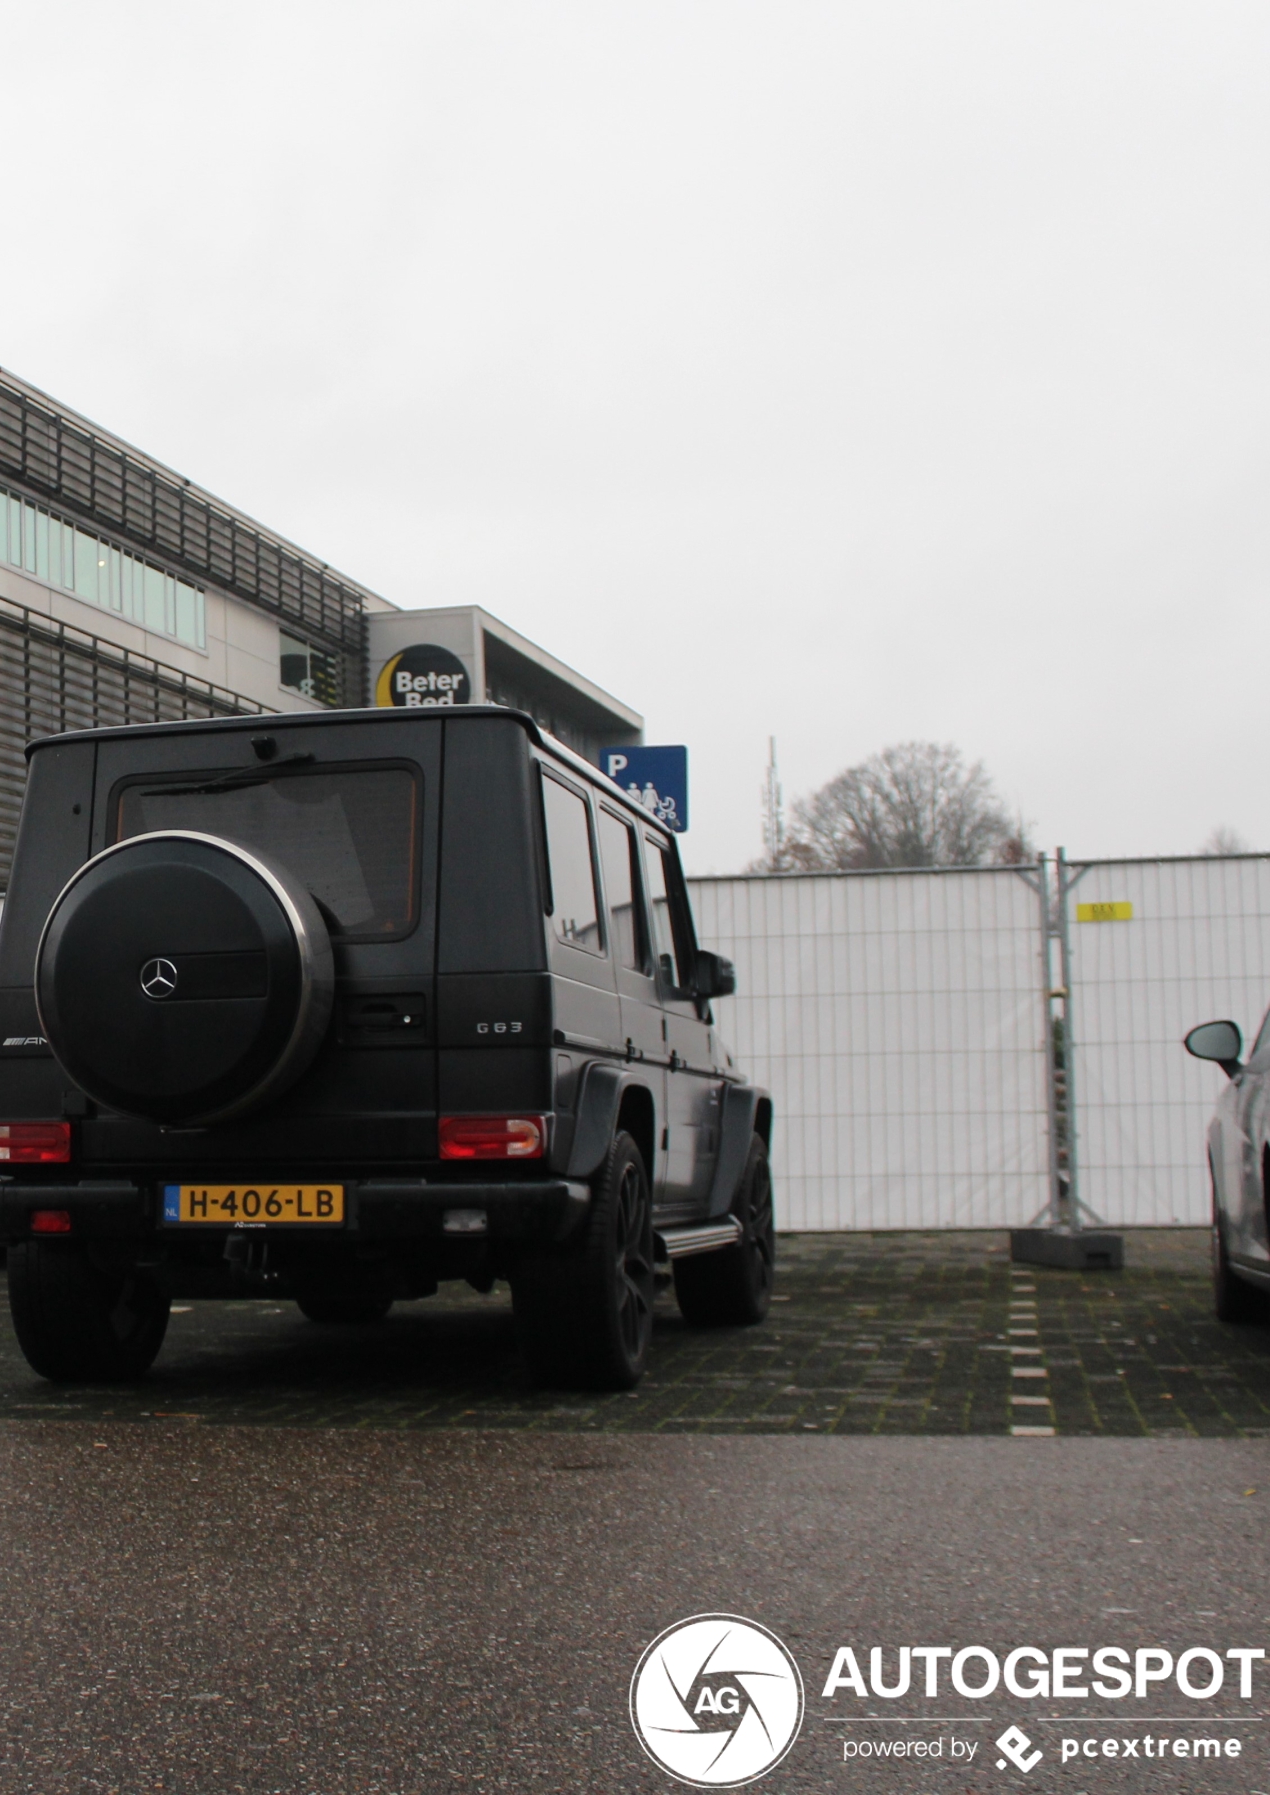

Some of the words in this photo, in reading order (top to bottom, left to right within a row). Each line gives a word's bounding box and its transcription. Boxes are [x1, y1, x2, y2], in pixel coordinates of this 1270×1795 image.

[396, 671, 464, 693] Beter
[607, 754, 628, 777] P
[165, 1207, 178, 1218] NL
[189, 1189, 334, 1219] H-406-LB
